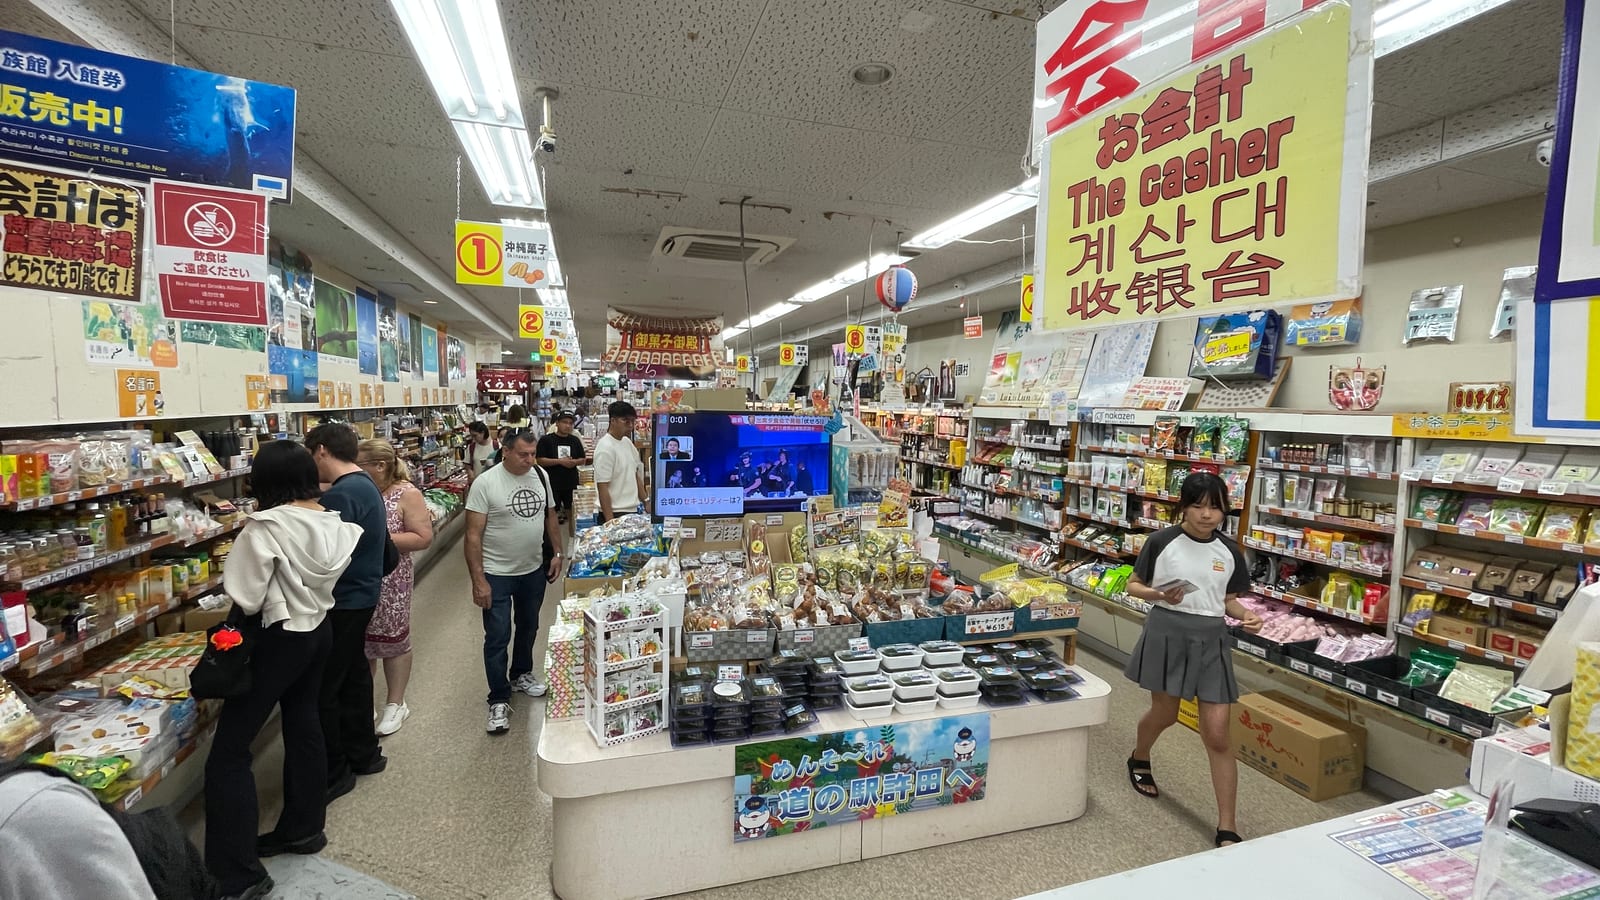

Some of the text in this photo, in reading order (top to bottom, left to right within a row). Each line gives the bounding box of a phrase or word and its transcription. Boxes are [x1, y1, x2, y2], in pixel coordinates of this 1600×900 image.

[57, 61, 122, 89] 入館券
[1096, 54, 1252, 169] お会計
[69, 151, 99, 162] Discount
[101, 156, 124, 166] Tickets
[1068, 116, 1295, 228] The casher
[193, 250, 228, 263] 飲食は
[472, 238, 486, 270] 1
[173, 262, 250, 278] ご遠慮ください
[1067, 251, 1284, 320] 收银台
[525, 314, 538, 330] 2
[883, 323, 901, 334] NEW
[635, 332, 698, 350] 御菓子御殿
[1104, 411, 1135, 420] nakazen
[1411, 416, 1512, 430] お茶コーナ
[777, 766, 978, 822] 道の駅許田へ
